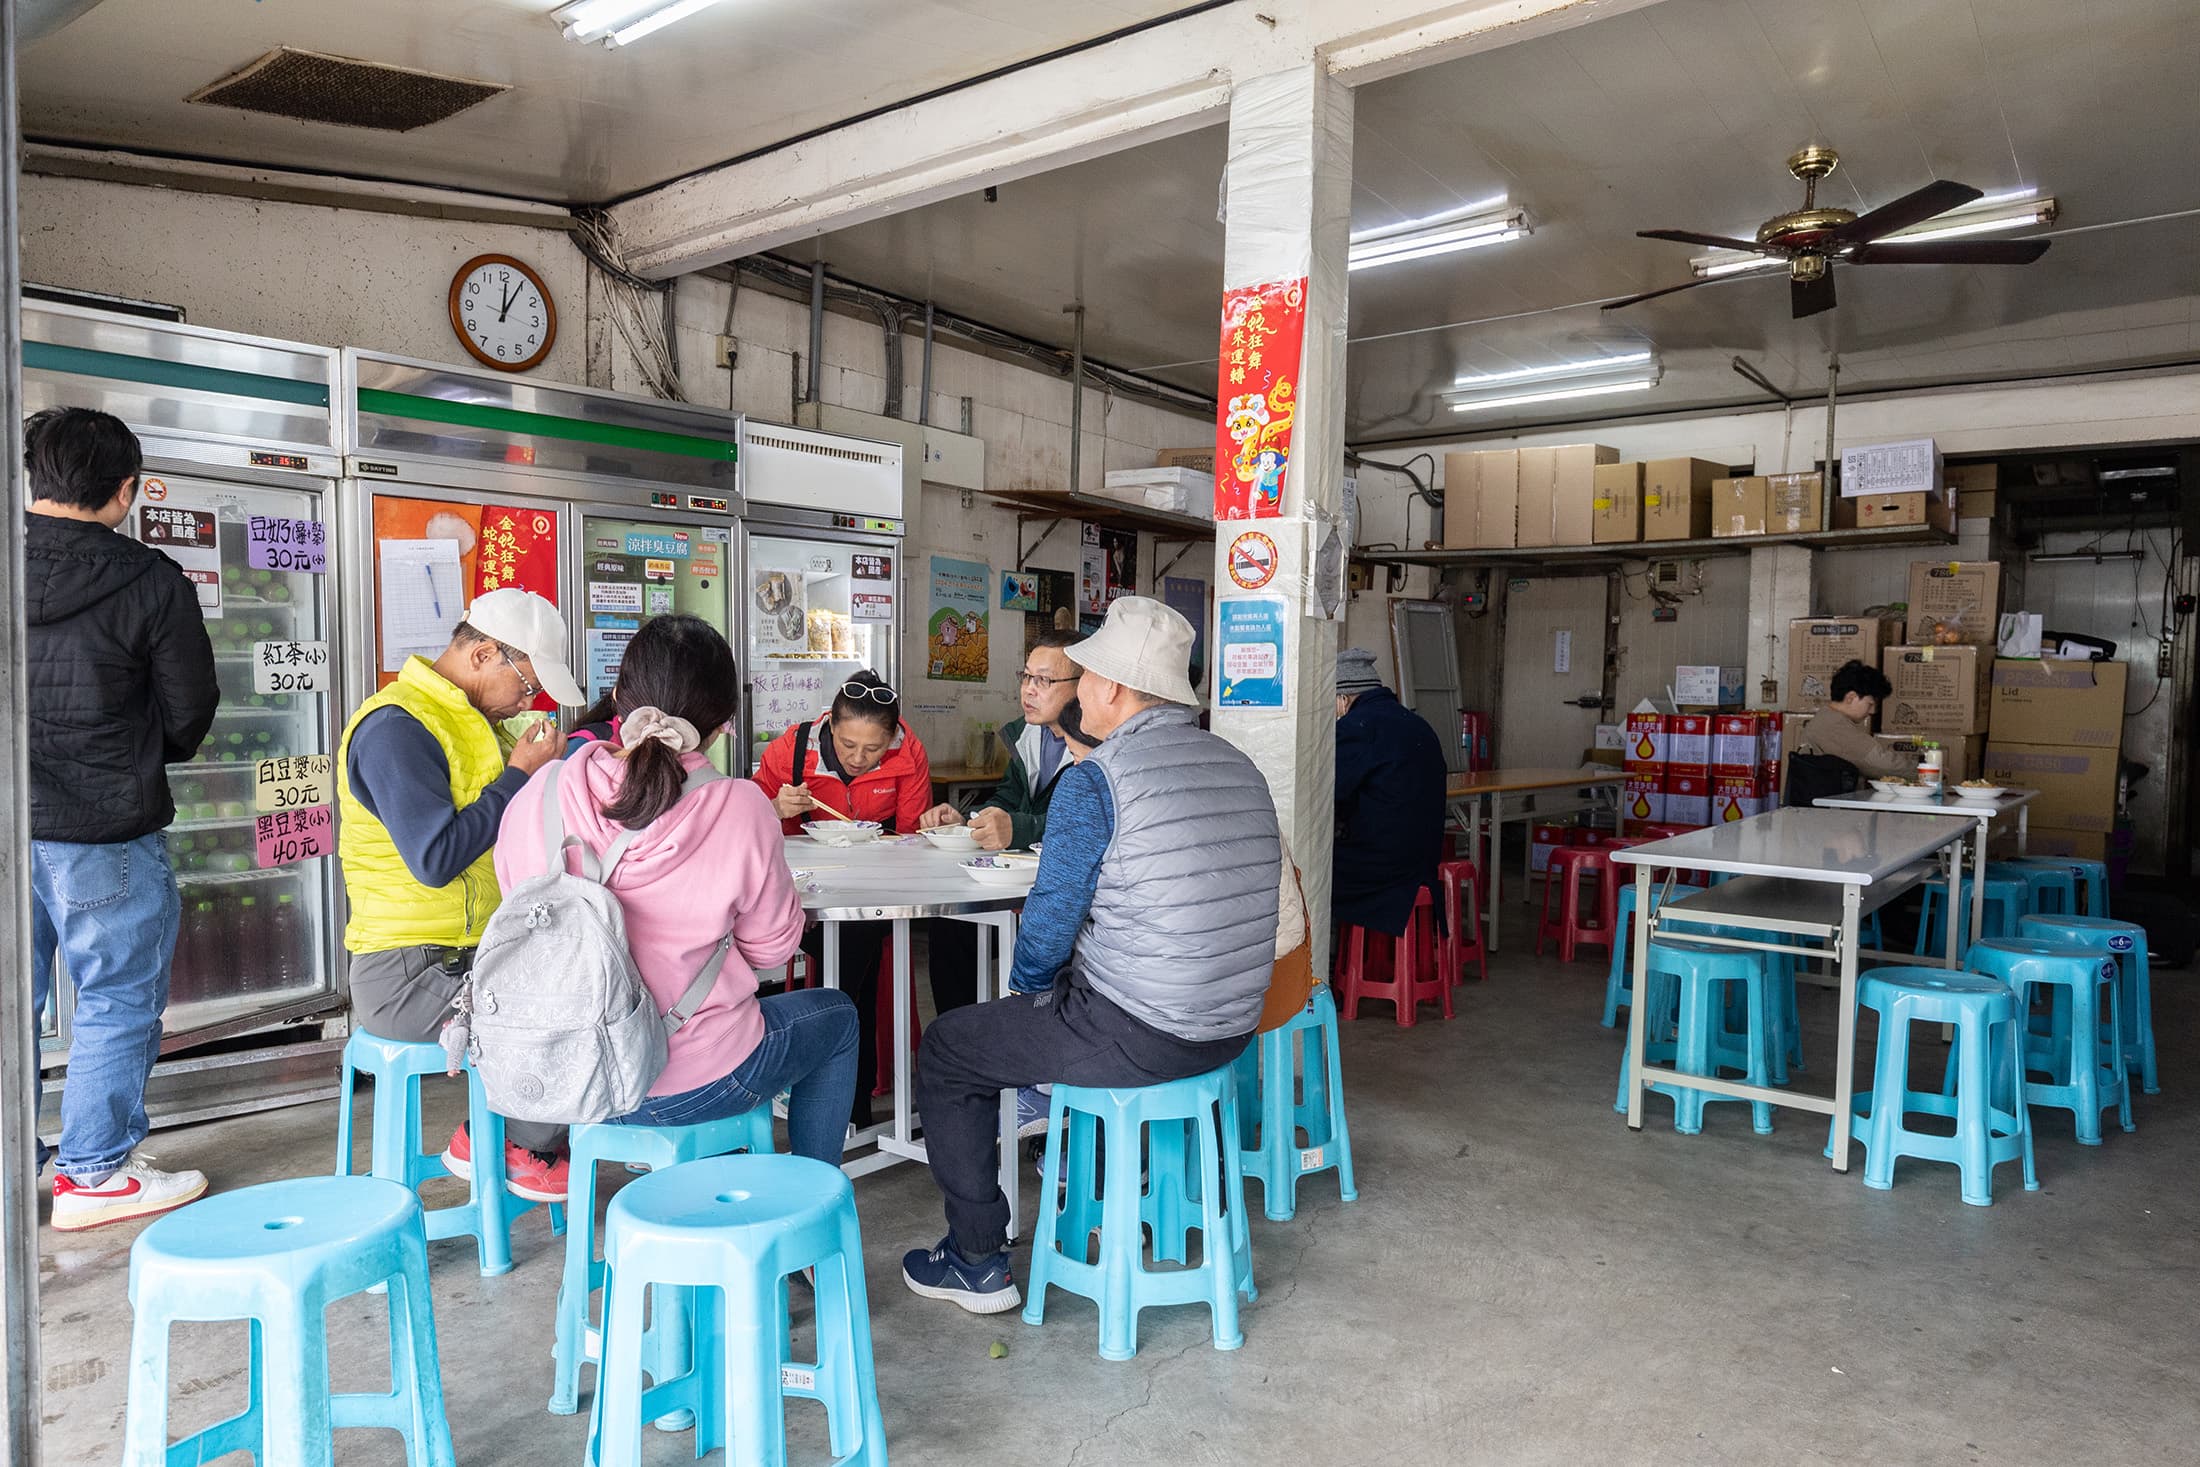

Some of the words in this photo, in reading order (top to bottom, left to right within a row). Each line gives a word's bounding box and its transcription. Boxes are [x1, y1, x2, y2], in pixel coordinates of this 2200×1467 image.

[483, 271, 492, 284] 11
[499, 270, 510, 283] 12
[468, 282, 480, 295] 10
[465, 299, 474, 311] 9
[529, 296, 537, 308] 2
[467, 319, 477, 331] 8
[530, 315, 539, 328] 3
[479, 335, 488, 347] 7
[527, 334, 535, 345] 4
[496, 345, 506, 357] 6
[514, 344, 522, 355] 5
[146, 508, 196, 526] 本店皆為
[482, 526, 500, 592] 蛇來運轉
[263, 641, 327, 666] 紅茶(小)
[271, 672, 313, 691] 30元
[2001, 688, 2019, 696] Lid
[259, 755, 331, 784] 白豆漿(小)
[274, 784, 320, 807] 30元
[258, 808, 331, 842] 黑豆漿(小)
[273, 836, 320, 864] 40元
